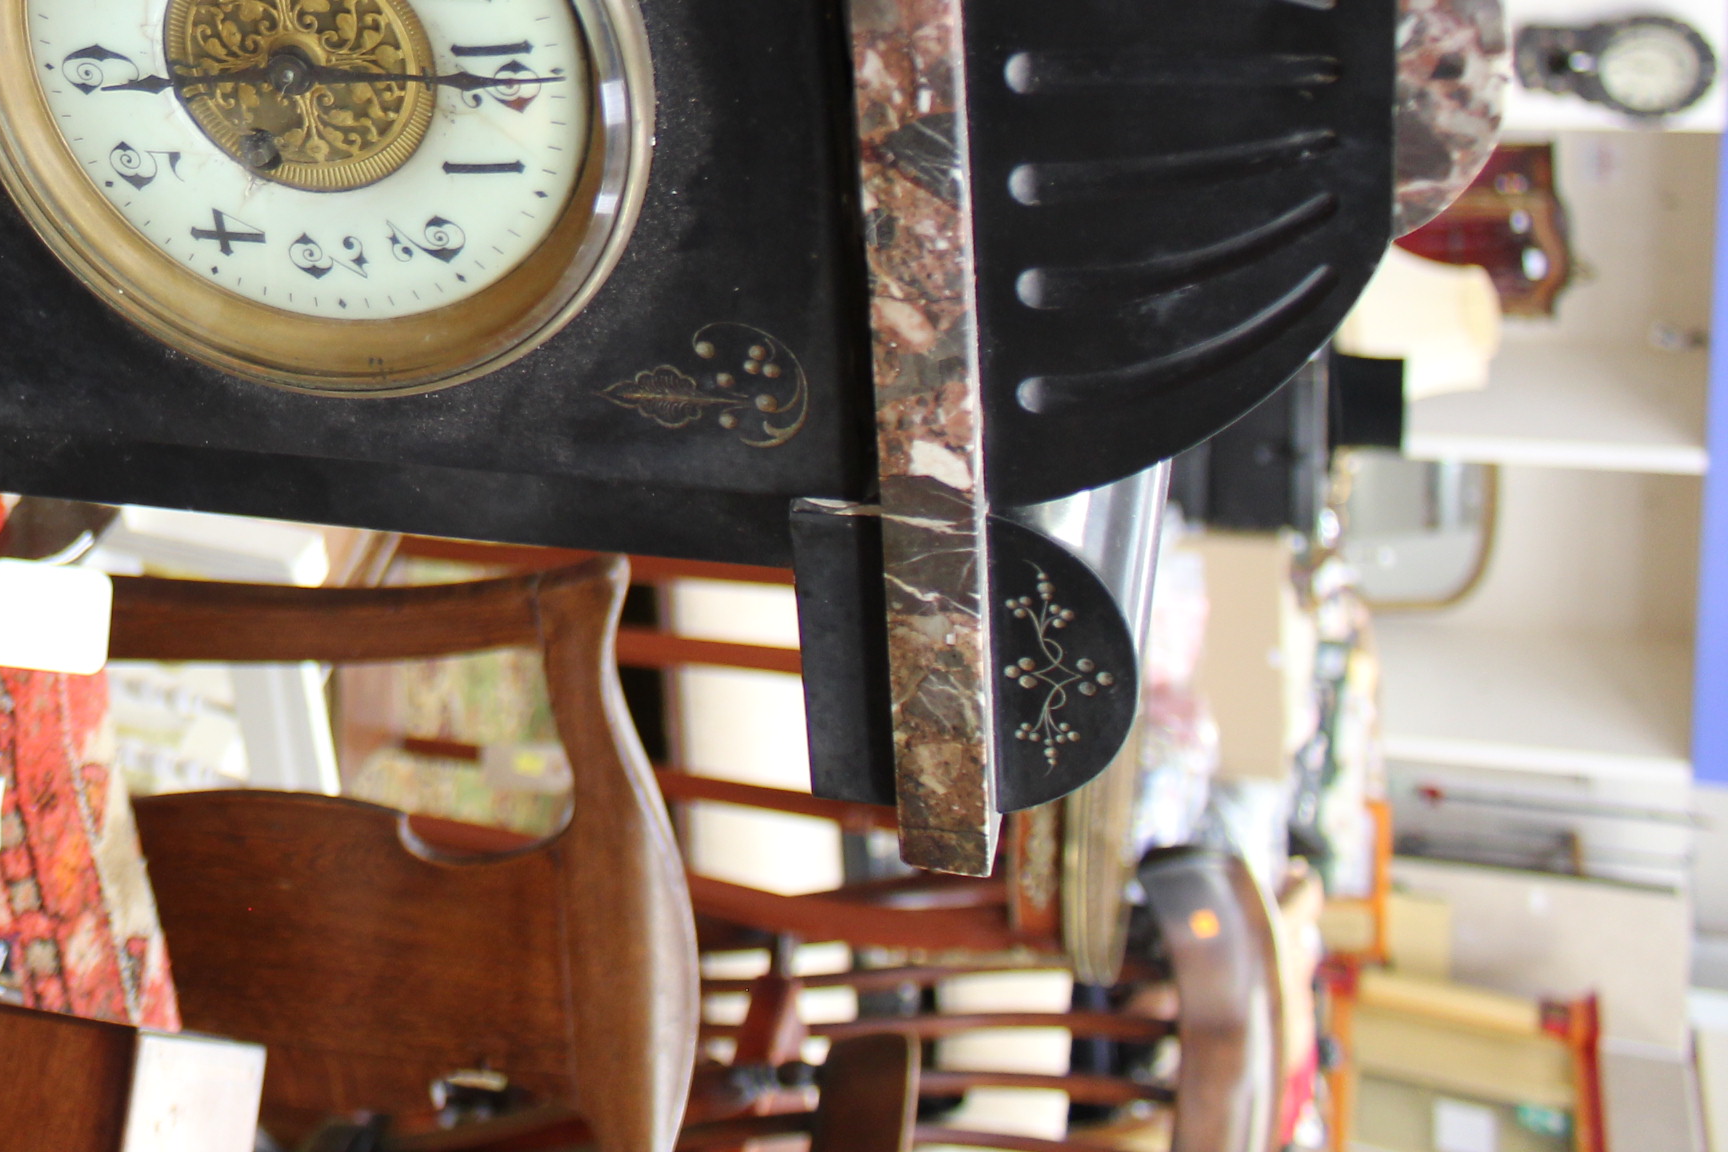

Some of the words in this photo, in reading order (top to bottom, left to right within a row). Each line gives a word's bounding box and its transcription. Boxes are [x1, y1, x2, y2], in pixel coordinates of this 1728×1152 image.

[61, 43, 140, 95] 6
[451, 39, 542, 113] 12
[108, 141, 185, 191] 5
[441, 160, 526, 175] 1
[190, 207, 267, 257] 4
[288, 232, 369, 280] 3
[385, 214, 466, 264] 2
